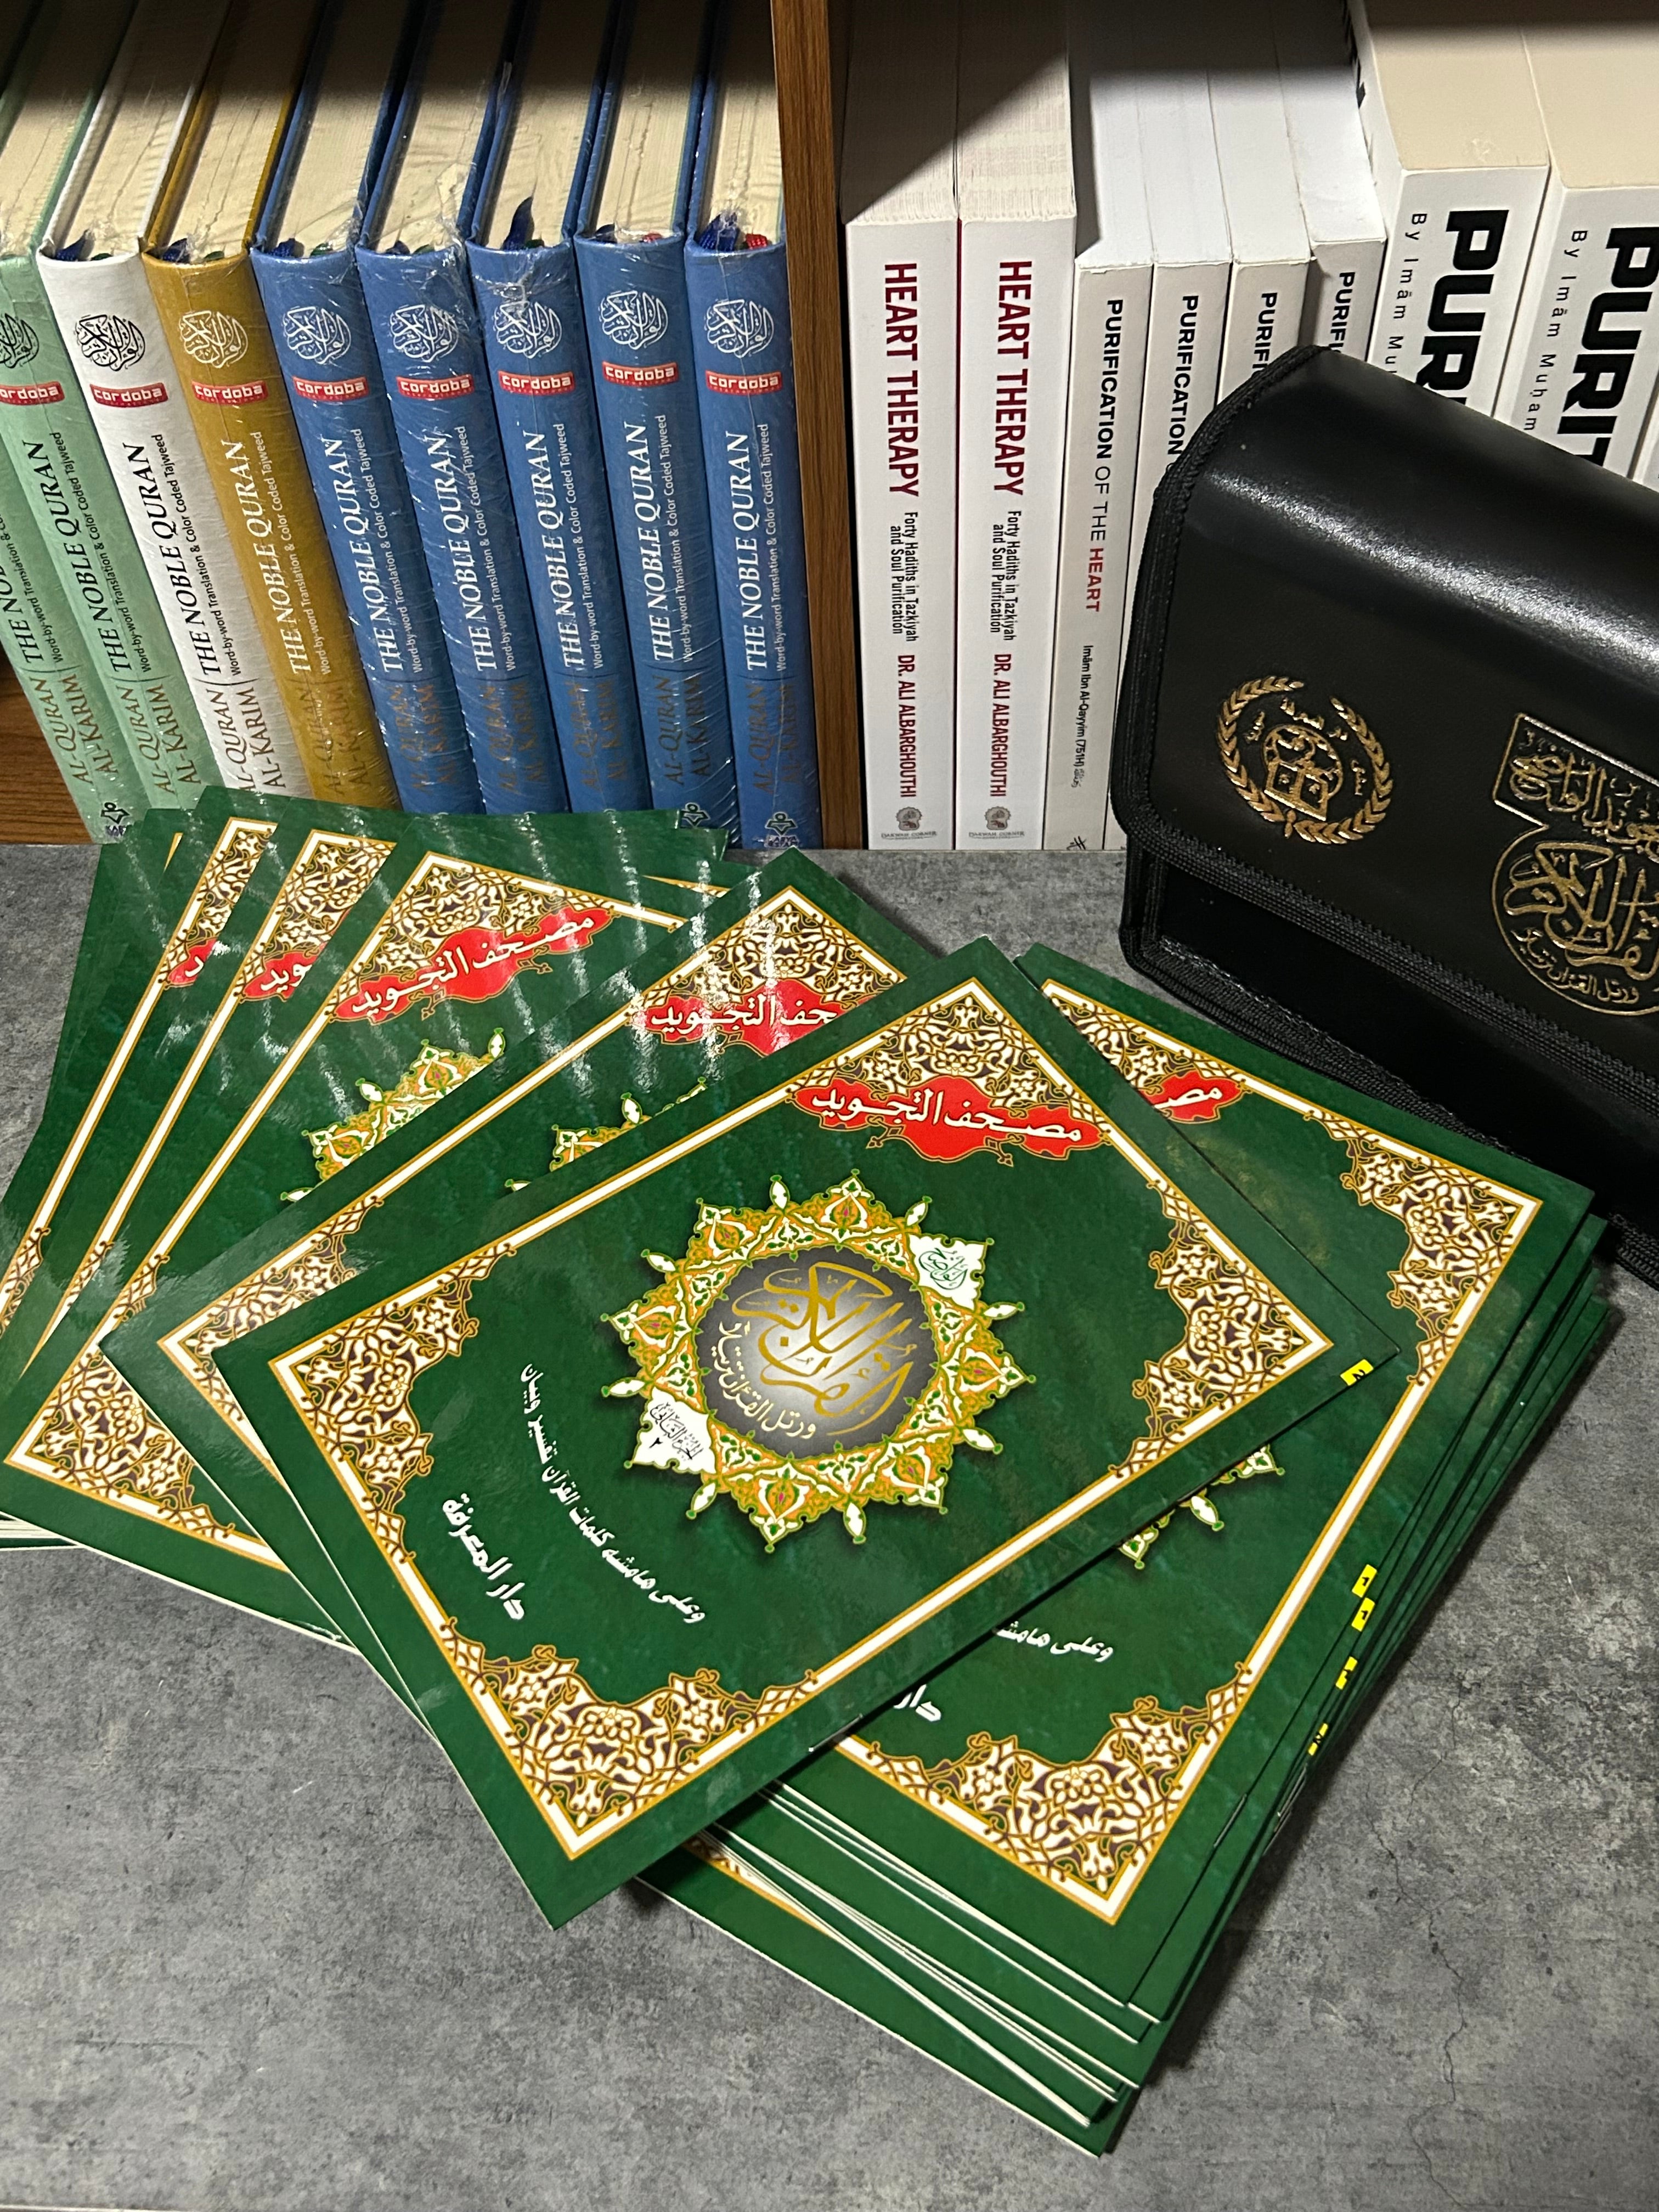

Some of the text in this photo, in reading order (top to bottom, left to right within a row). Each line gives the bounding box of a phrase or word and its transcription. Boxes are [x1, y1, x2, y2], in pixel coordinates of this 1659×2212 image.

[1406, 213, 1427, 240] By
[1564, 230, 1587, 258] By
[1329, 272, 1355, 353] PURIFI
[1393, 258, 1419, 319] Imām
[1415, 210, 1509, 404] PUR
[1547, 276, 1576, 337] Imām
[0, 387, 59, 399] ordoba
[94, 387, 162, 402] cordoba
[195, 385, 263, 399] cordoba
[296, 381, 364, 395] cordoba
[400, 377, 470, 392] cordoba
[502, 376, 571, 390] cordoba
[606, 367, 675, 381] cordoba
[709, 376, 779, 390] cordoba
[884, 263, 919, 496] HEART THERAPY
[994, 261, 1032, 495] HEART THERAPY
[1167, 295, 1199, 455] PURIFICATION
[49, 432, 75, 477] Tajweed
[151, 434, 175, 477] Tajweed
[250, 432, 273, 475] Tajweed
[351, 429, 371, 473] Tajweed
[1086, 299, 1124, 612] PURIFICATION OF THE HEART
[69, 477, 89, 511] Coded
[167, 479, 187, 512] Coded
[264, 478, 283, 511] Coded
[363, 475, 380, 509] Coded
[85, 513, 100, 539] Color
[182, 516, 196, 542] Color
[277, 515, 292, 541] Color
[374, 511, 388, 539] Color
[523, 430, 586, 668] THE NOBLE QURAN
[552, 423, 603, 669] Word-by-word Translation & Color Coded Tajweed
[623, 421, 674, 661] THE NOBLE QURAN
[654, 414, 693, 663] Word-by-word Translation & Color Coded Tajweed
[725, 431, 768, 670] THE NOBLE QURAN
[757, 424, 786, 672] Word-by-word Translation & Color Coded Tajweed
[7, 543, 34, 595] Translation
[22, 440, 132, 672] THE NOBLE QURAN
[99, 552, 125, 605] Translation
[122, 442, 221, 675] THE NOBLE QURAN
[221, 439, 311, 675] THE NOBLE QURAN
[289, 554, 311, 607] Translation
[321, 437, 403, 673] THE NOBLE QURAN
[385, 551, 405, 605] Translation
[424, 436, 497, 671] THE NOBLE QURAN
[890, 526, 905, 634] and Soul Purification
[902, 512, 919, 641] Forty Hadiths in Tazkiyah
[990, 524, 1006, 633] and Soul Purification
[1002, 511, 1022, 641] Forty Hadiths in Tazkiyah
[195, 555, 219, 608] Translation
[9, 619, 44, 663] THE
[32, 597, 64, 663] Word-by-word
[119, 607, 152, 672] Word-by-word
[210, 610, 241, 676] Word-by-word
[303, 608, 331, 675] Word-by-word
[397, 607, 423, 673] Word-by-word
[1081, 674, 1091, 689] Ibn
[29, 676, 93, 785] AL-QURAN
[61, 674, 119, 774] AL-KARIM
[116, 685, 176, 794] AL-QURAN
[146, 684, 201, 785] AL-KARIM
[236, 687, 286, 788] AL-KARIM
[898, 655, 916, 797] DR. ALI ALBARGHOUTHI
[990, 654, 1011, 796] DR. ALI ALBARGHOUTHI
[473, 917, 594, 968] مصحف
[353, 946, 469, 1014] التجويد
[651, 994, 837, 1034] حف التجويد
[812, 1088, 1081, 1141] مصحف التجويد
[1154, 1087, 1222, 1109] مص
[528, 1415, 558, 1464] تفسير
[569, 1507, 614, 1547] كلمات
[443, 1493, 525, 1620] دار المعرفة
[648, 1590, 706, 1623] وعلى
[995, 1621, 1113, 1662] وعلى هامش
[894, 1684, 941, 1722] دار
